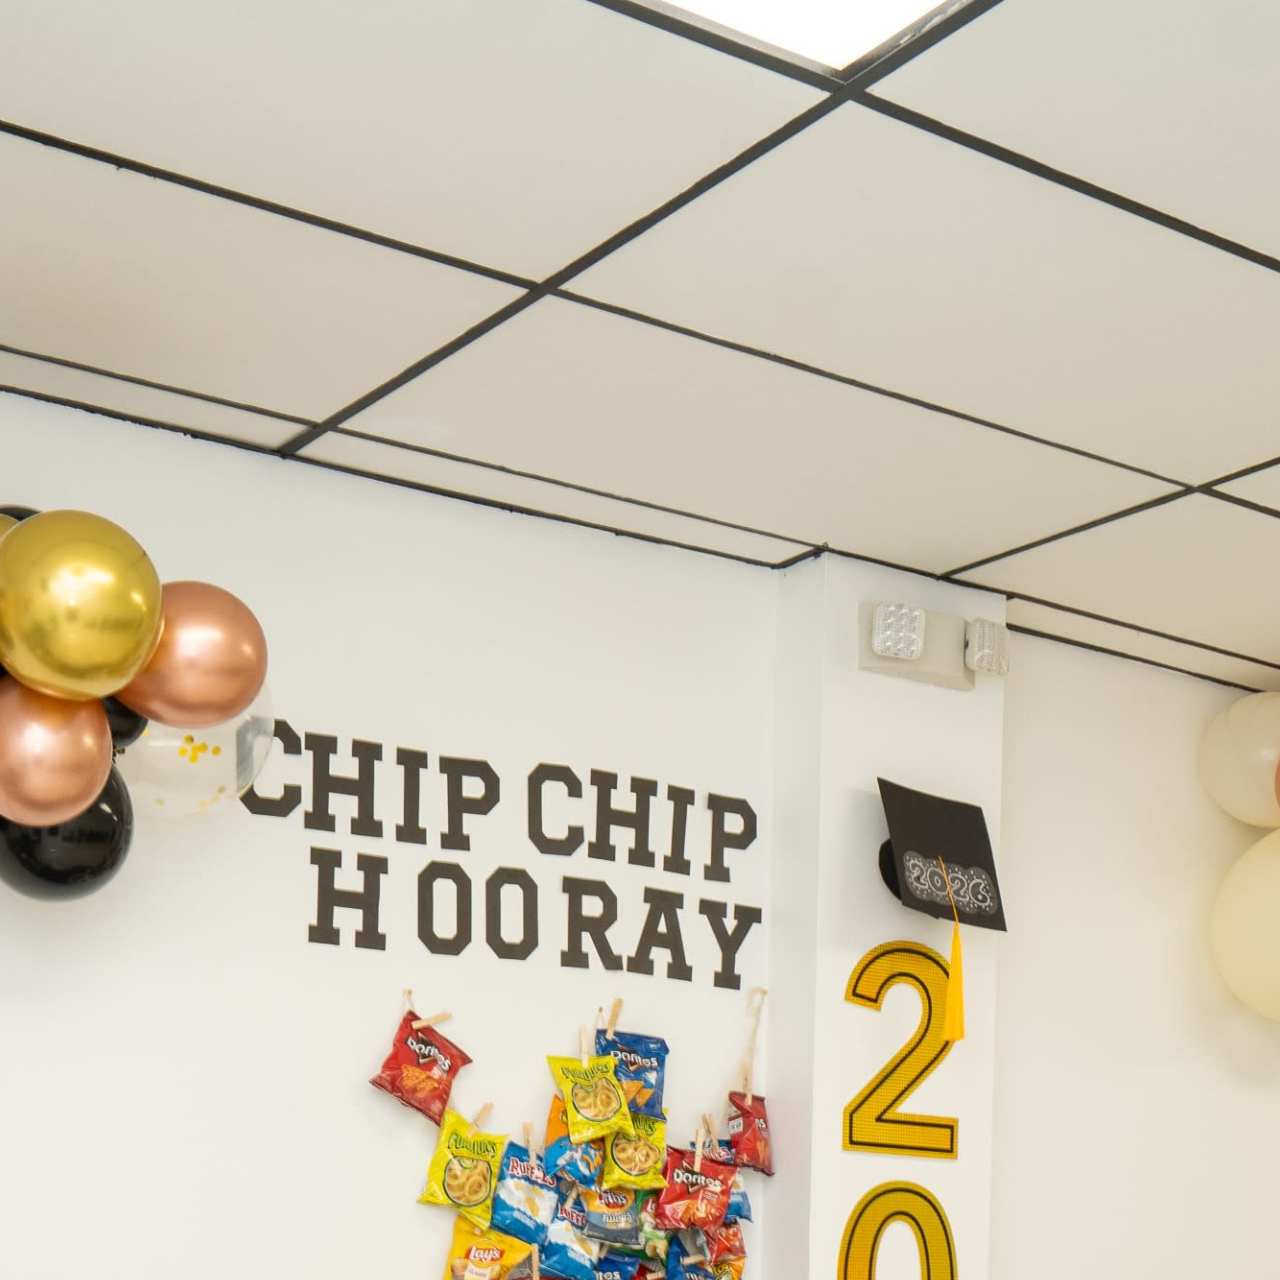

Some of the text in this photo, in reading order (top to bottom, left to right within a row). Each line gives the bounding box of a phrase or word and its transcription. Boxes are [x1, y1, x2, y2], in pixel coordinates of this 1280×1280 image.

[237, 719, 757, 882] CHIP CHIP
[909, 859, 991, 906] 2026
[308, 847, 762, 990] HOORAY
[406, 1035, 452, 1073] Doritos
[610, 1050, 659, 1068] Doritos
